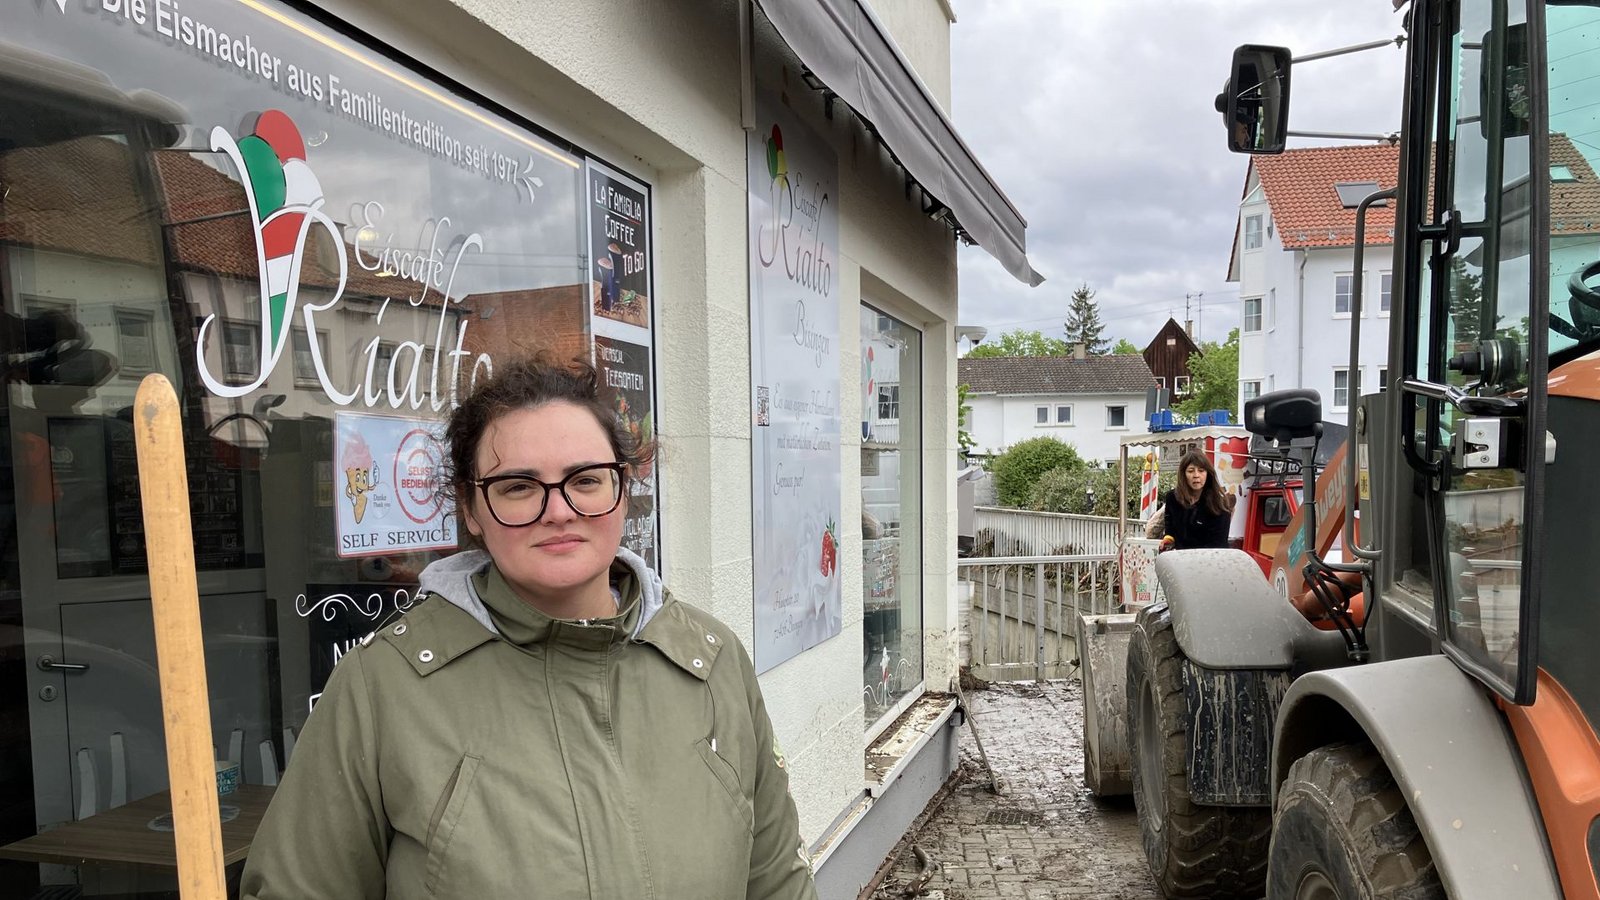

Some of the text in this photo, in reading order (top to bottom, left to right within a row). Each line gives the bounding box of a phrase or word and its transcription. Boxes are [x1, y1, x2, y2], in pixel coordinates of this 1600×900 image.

[154, 0, 281, 82] Eismacher
[288, 64, 323, 101] aus
[329, 74, 462, 162] Familientradition
[465, 143, 490, 173] seit
[492, 153, 519, 184] 1977
[608, 186, 642, 222] FAMIGLIA
[759, 133, 832, 298] Rialto
[604, 214, 635, 247] COFFEE
[793, 299, 830, 368] Bisingen
[343, 529, 452, 549] SELF SERVICE
